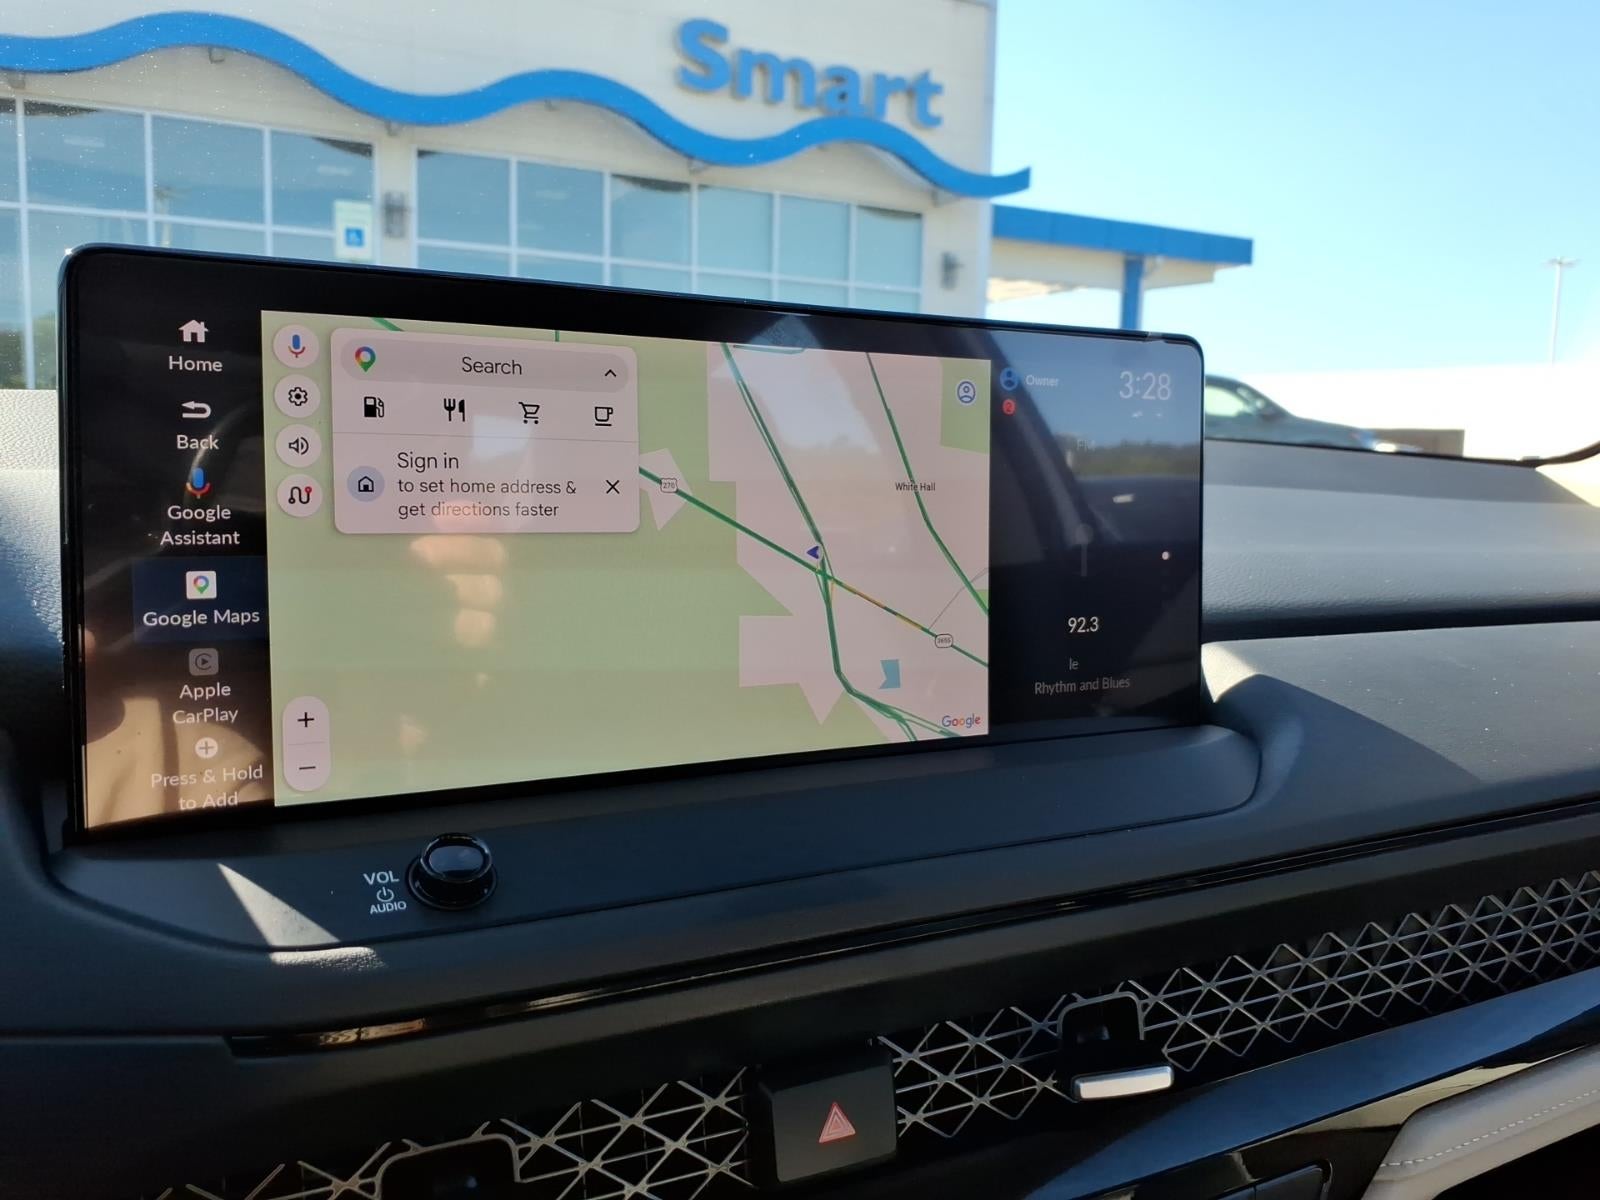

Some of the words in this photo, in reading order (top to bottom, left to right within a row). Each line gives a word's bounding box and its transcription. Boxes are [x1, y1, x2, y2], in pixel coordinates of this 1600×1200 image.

[677, 18, 944, 127] Smart
[168, 356, 223, 372] Home
[461, 357, 523, 375] Search
[1025, 374, 1059, 387] Owner
[1119, 371, 1172, 400] 3:28
[177, 435, 219, 450] Back
[397, 452, 437, 472] Sign
[444, 452, 459, 468] in
[398, 479, 414, 493] to
[420, 479, 444, 494] set
[451, 478, 496, 494] home
[500, 478, 561, 494] address
[566, 480, 576, 494] &
[895, 482, 917, 492] White
[919, 482, 936, 492] Hall
[167, 506, 231, 521] Google
[398, 504, 425, 519] get
[431, 500, 510, 516] directions
[515, 501, 559, 516] faster
[160, 531, 240, 545] Assistant
[143, 610, 207, 628] Google
[213, 609, 260, 624] Maps
[1068, 616, 1099, 633] 92.3
[179, 682, 231, 701] Apple
[1034, 680, 1077, 696] Rhythm
[1079, 678, 1099, 692] and
[1101, 676, 1131, 690] Blues
[173, 708, 239, 725] CarPlay
[941, 713, 982, 729] Google
[151, 773, 197, 788] Press
[202, 770, 217, 784] &
[223, 764, 263, 781] Hold
[179, 797, 197, 811] to
[202, 792, 239, 808] Add
[363, 870, 400, 885] VOL
[369, 900, 407, 915] AUDIO
